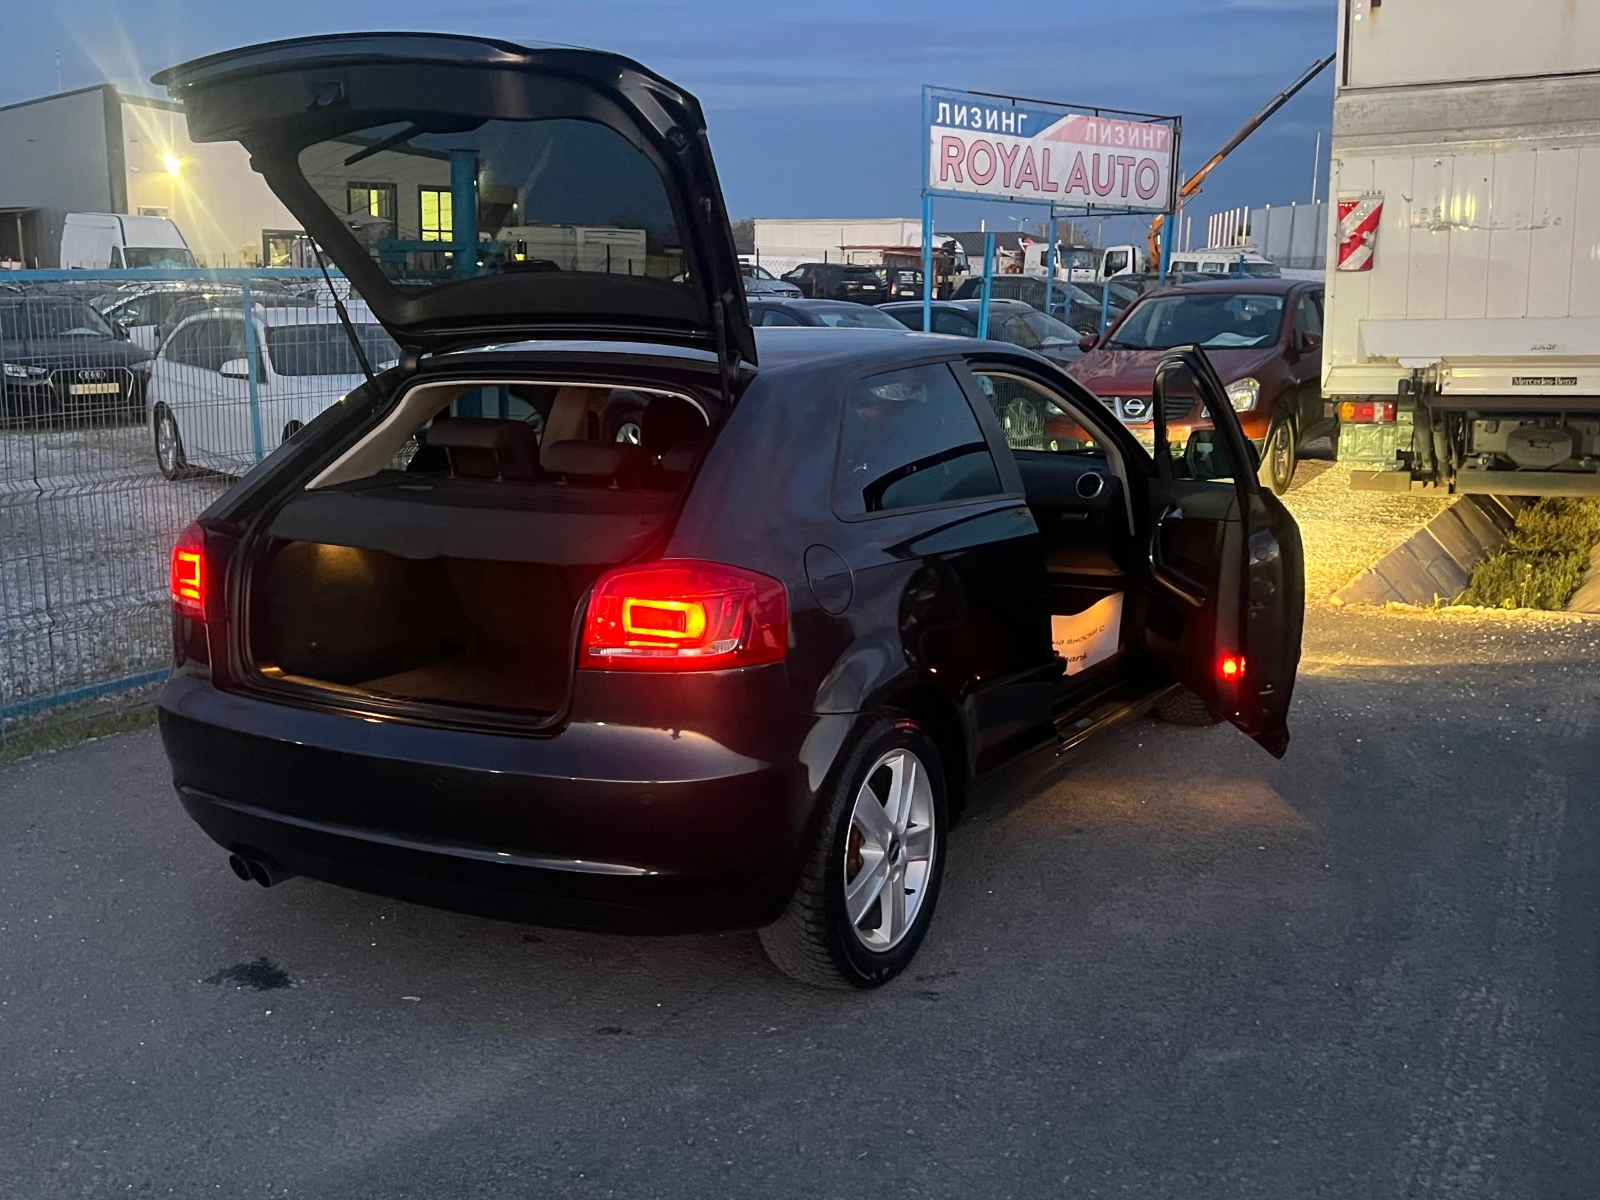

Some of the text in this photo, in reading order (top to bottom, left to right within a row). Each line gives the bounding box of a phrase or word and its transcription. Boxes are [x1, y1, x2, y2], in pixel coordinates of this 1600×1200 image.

[936, 102, 1028, 134] ЛИЗИНГ
[1085, 122, 1169, 149] ЛИЗИНГ
[940, 136, 1160, 200] ROYAL AUTO
[1513, 377, 1577, 385] Mercedes-Benz
